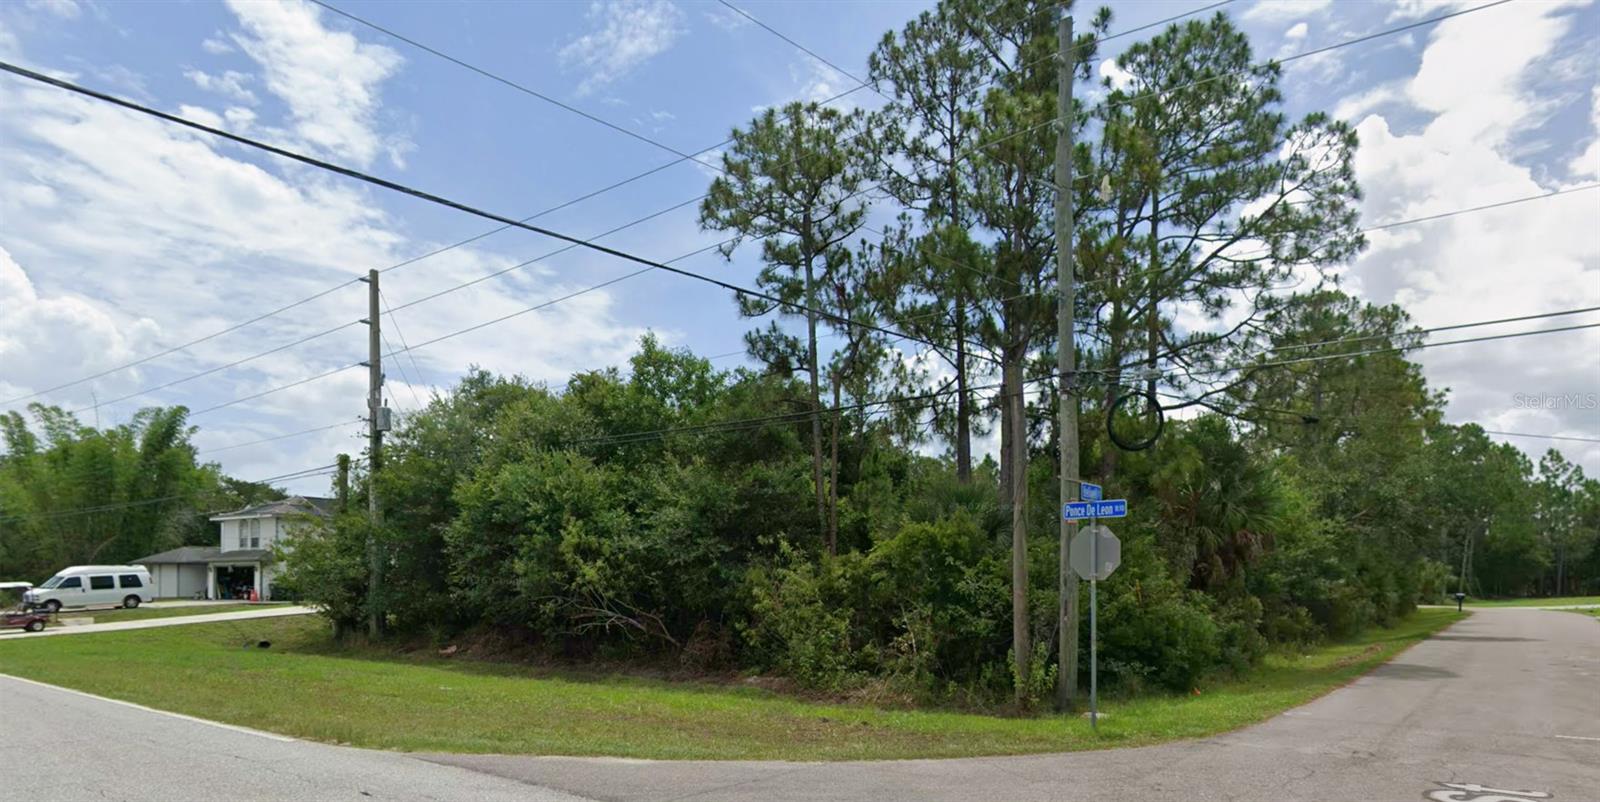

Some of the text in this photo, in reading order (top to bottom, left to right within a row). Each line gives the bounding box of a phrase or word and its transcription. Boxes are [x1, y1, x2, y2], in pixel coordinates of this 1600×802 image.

[1065, 505, 1085, 517] Ponce
[1086, 504, 1096, 516] De
[1097, 503, 1113, 515] Leon
